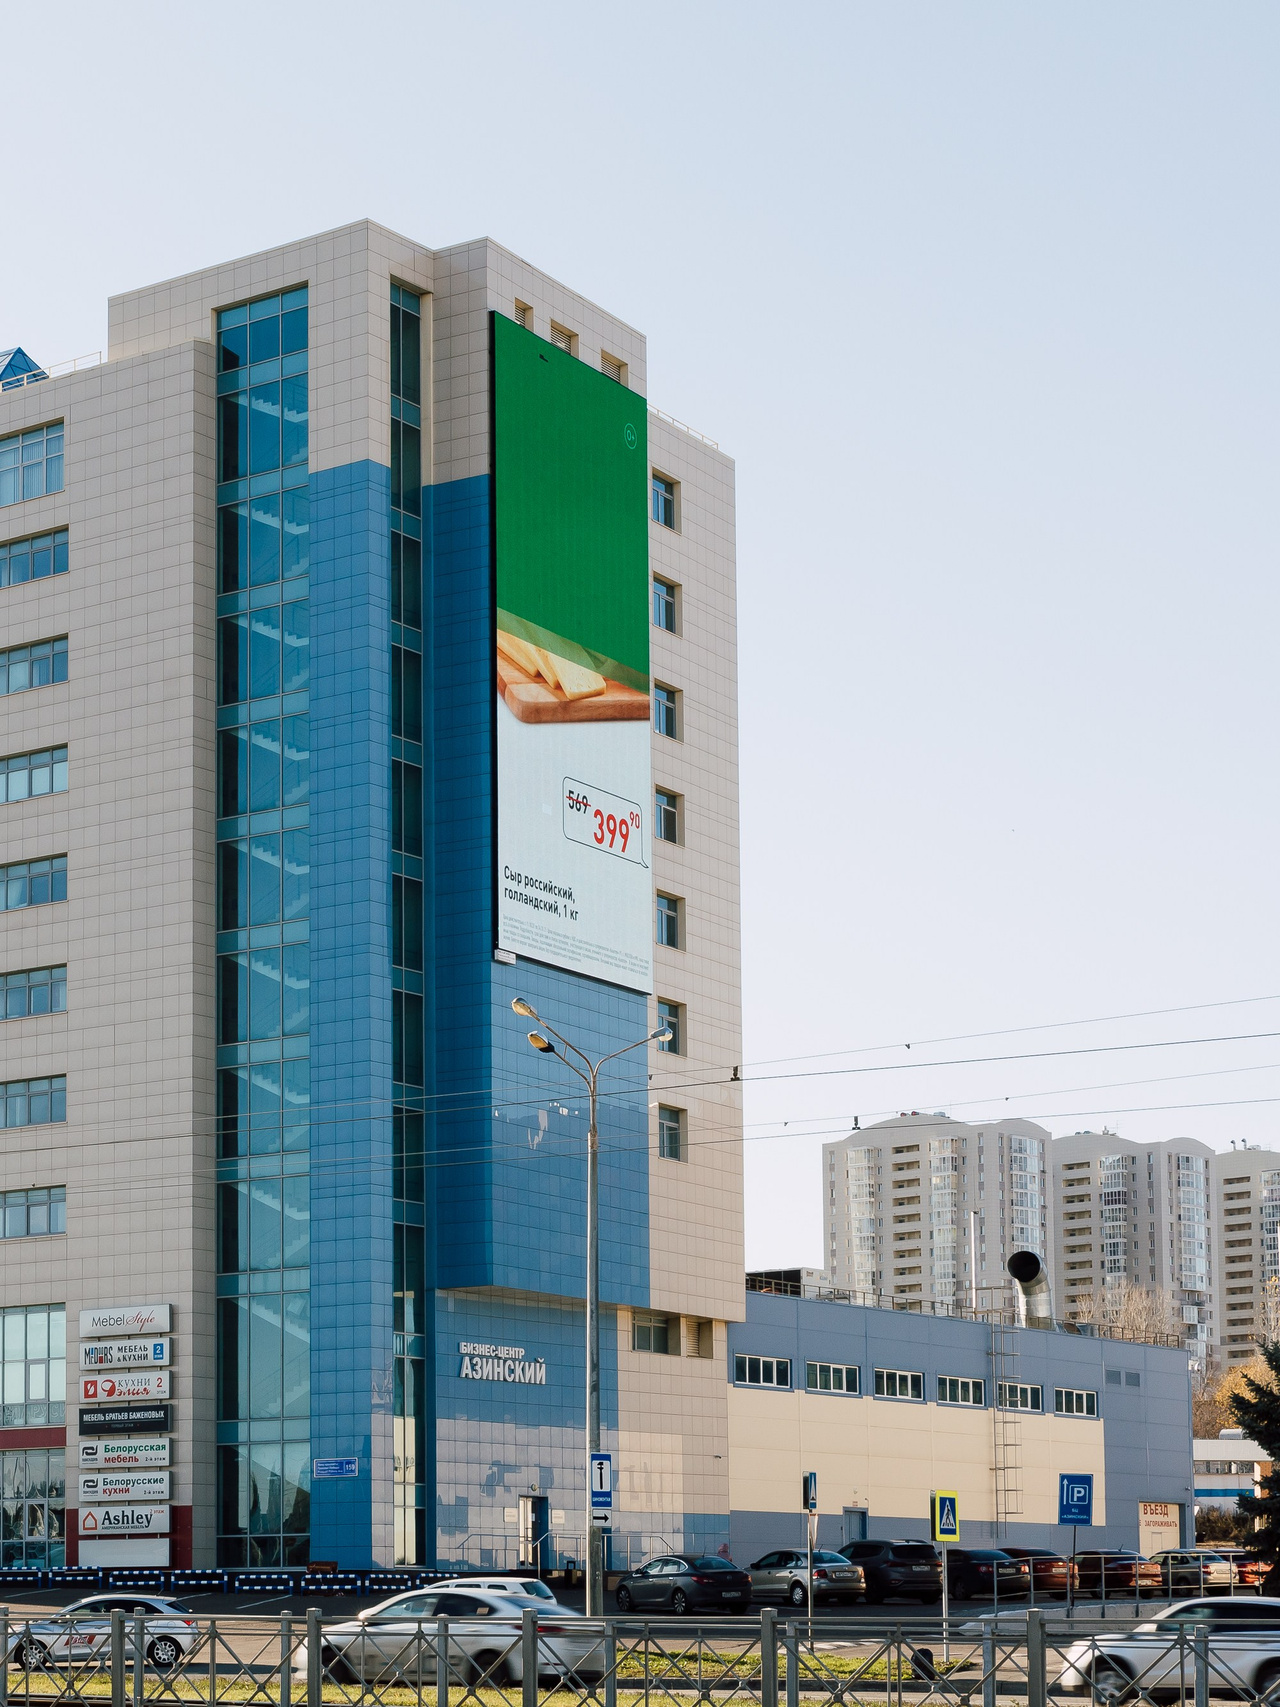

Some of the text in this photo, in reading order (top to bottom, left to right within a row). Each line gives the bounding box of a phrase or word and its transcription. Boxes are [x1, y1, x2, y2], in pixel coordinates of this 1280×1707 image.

[566, 790, 591, 814] 569
[594, 809, 629, 853] 399
[504, 865, 575, 904] Сыр российский,
[504, 887, 579, 921] голландский, 1 кг
[117, 1345, 148, 1353] МЕБЕЛЬ
[459, 1342, 525, 1359] БИЗНЕС-ЦЕНТР
[122, 1353, 148, 1362] КУХНИ
[460, 1356, 546, 1385] АЗИНСКИЙ
[156, 1377, 163, 1388] 2
[83, 1410, 165, 1422] МЕБЕЛЬ БРАТЬЕВ БАЖЕНОВЫХ
[104, 1444, 166, 1454] Белорусская
[104, 1454, 139, 1463] мебель
[102, 1477, 165, 1487] Белорусские
[102, 1487, 130, 1496] кухни
[1143, 1503, 1169, 1518] ВЪЕЗД
[101, 1509, 153, 1528] Ashley
[1144, 1520, 1178, 1528] ЗАГОРАЖИВАТЬ
